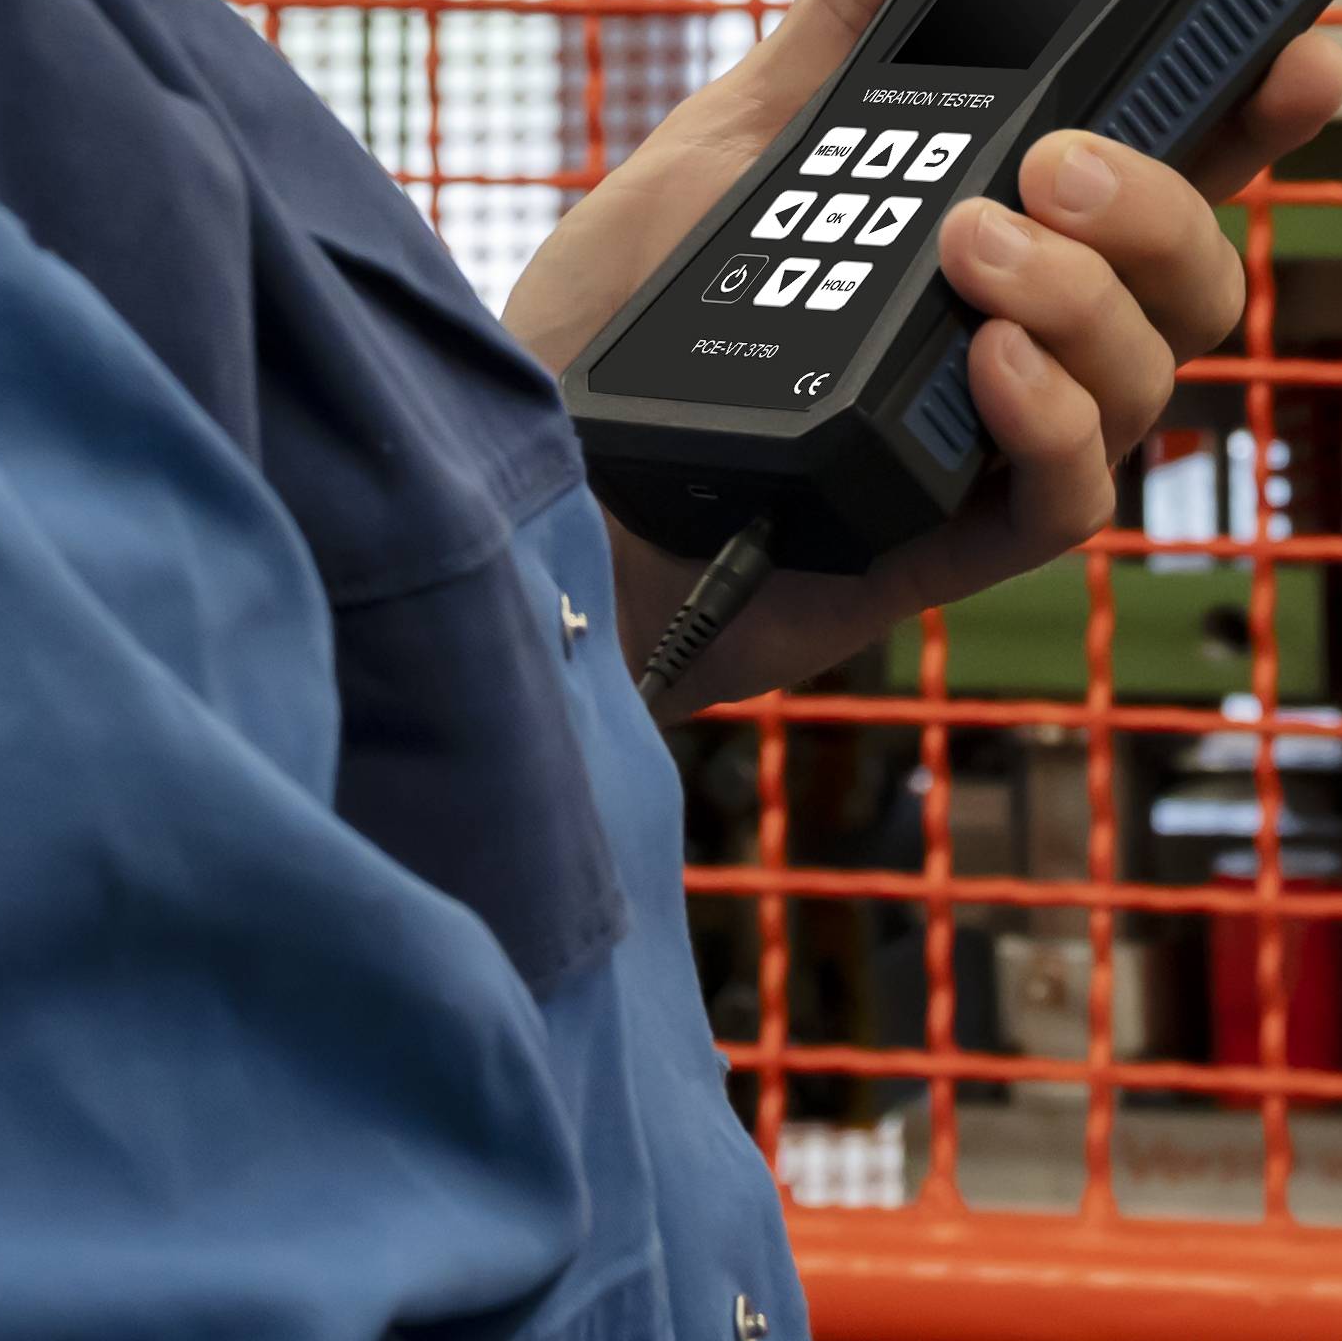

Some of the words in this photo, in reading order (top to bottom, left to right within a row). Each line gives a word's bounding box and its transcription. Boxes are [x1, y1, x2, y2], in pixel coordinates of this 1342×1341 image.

[863, 89, 938, 106] VIBRATION
[937, 92, 995, 109] TESTER
[814, 145, 853, 158] MENU
[825, 212, 848, 224] OK
[820, 279, 856, 292] HOLD
[690, 339, 748, 356] PCE-VT
[743, 343, 780, 359] 3750
